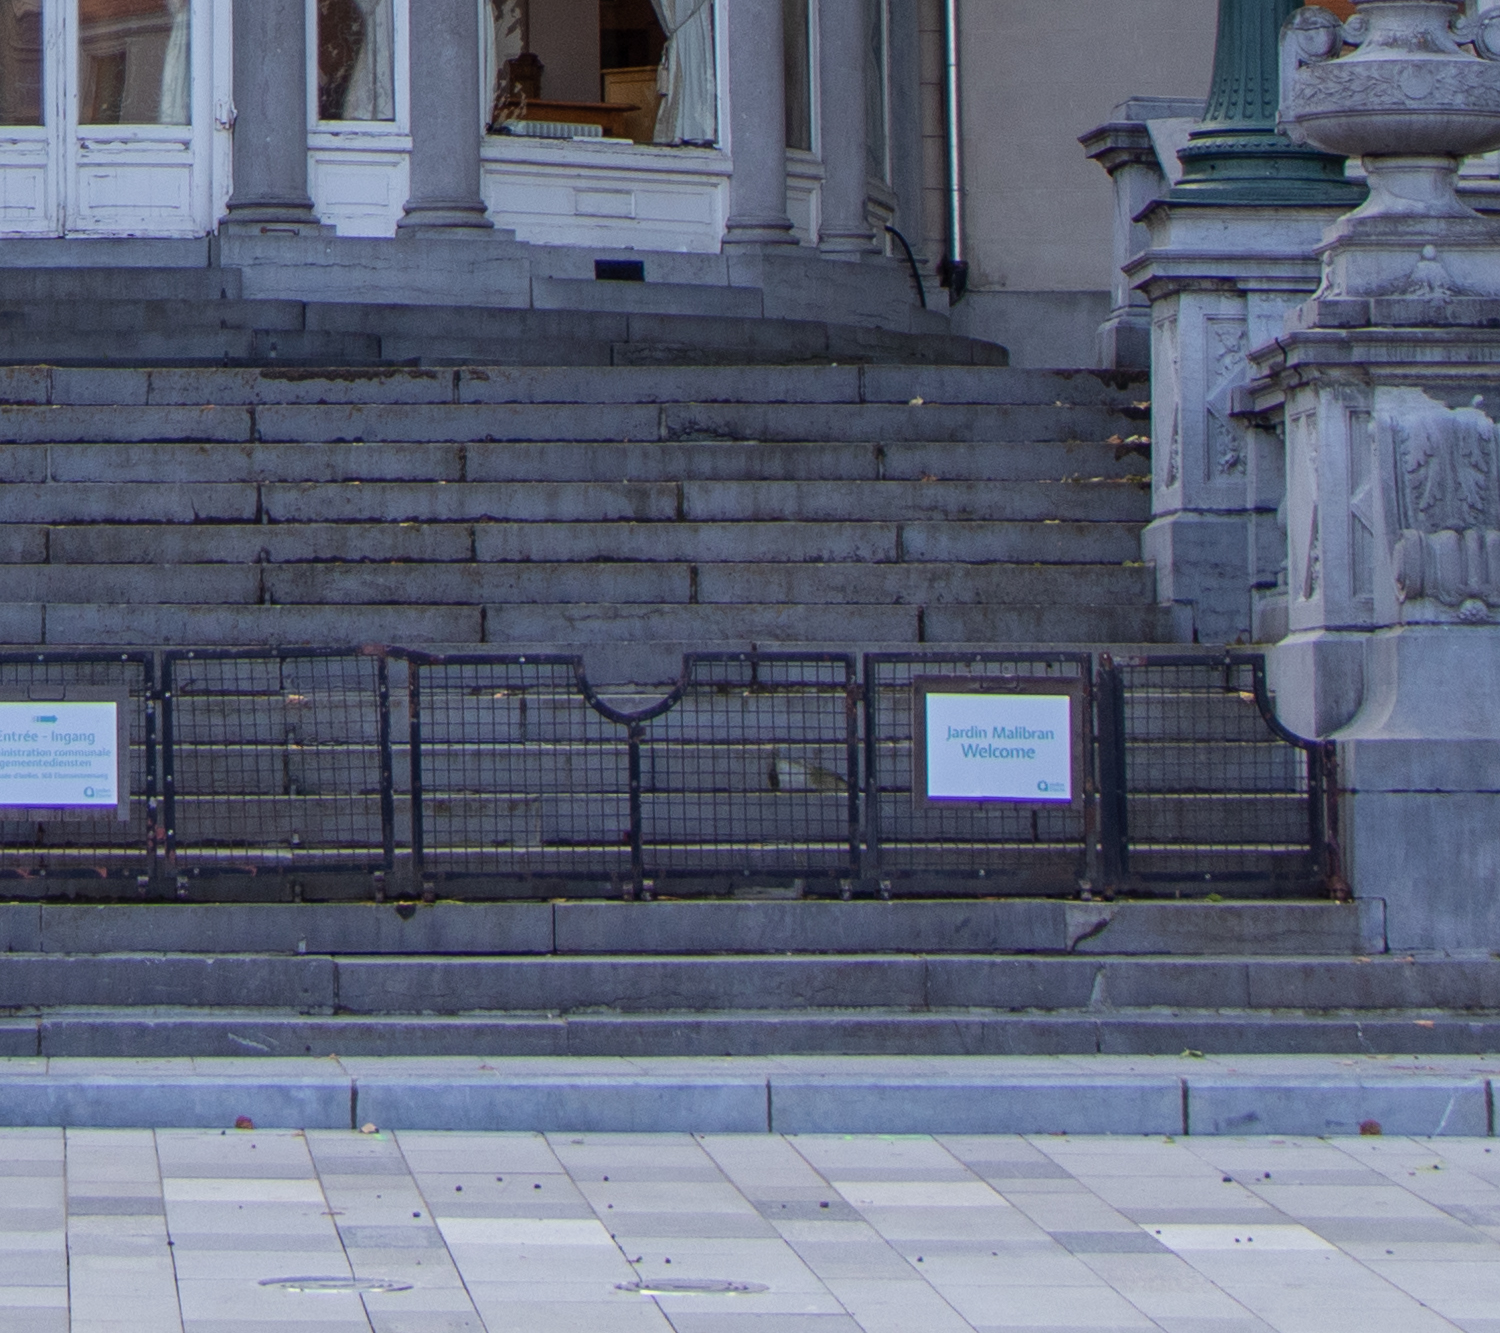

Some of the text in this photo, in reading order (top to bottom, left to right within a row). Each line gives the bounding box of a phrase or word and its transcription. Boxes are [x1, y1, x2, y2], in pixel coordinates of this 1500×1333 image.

[51, 731, 96, 745] Ingang
[946, 725, 1055, 741] Jardin Malibran
[54, 748, 111, 757] communale
[961, 743, 1036, 759] Welcome
[0, 758, 92, 770] gemeentediensten
